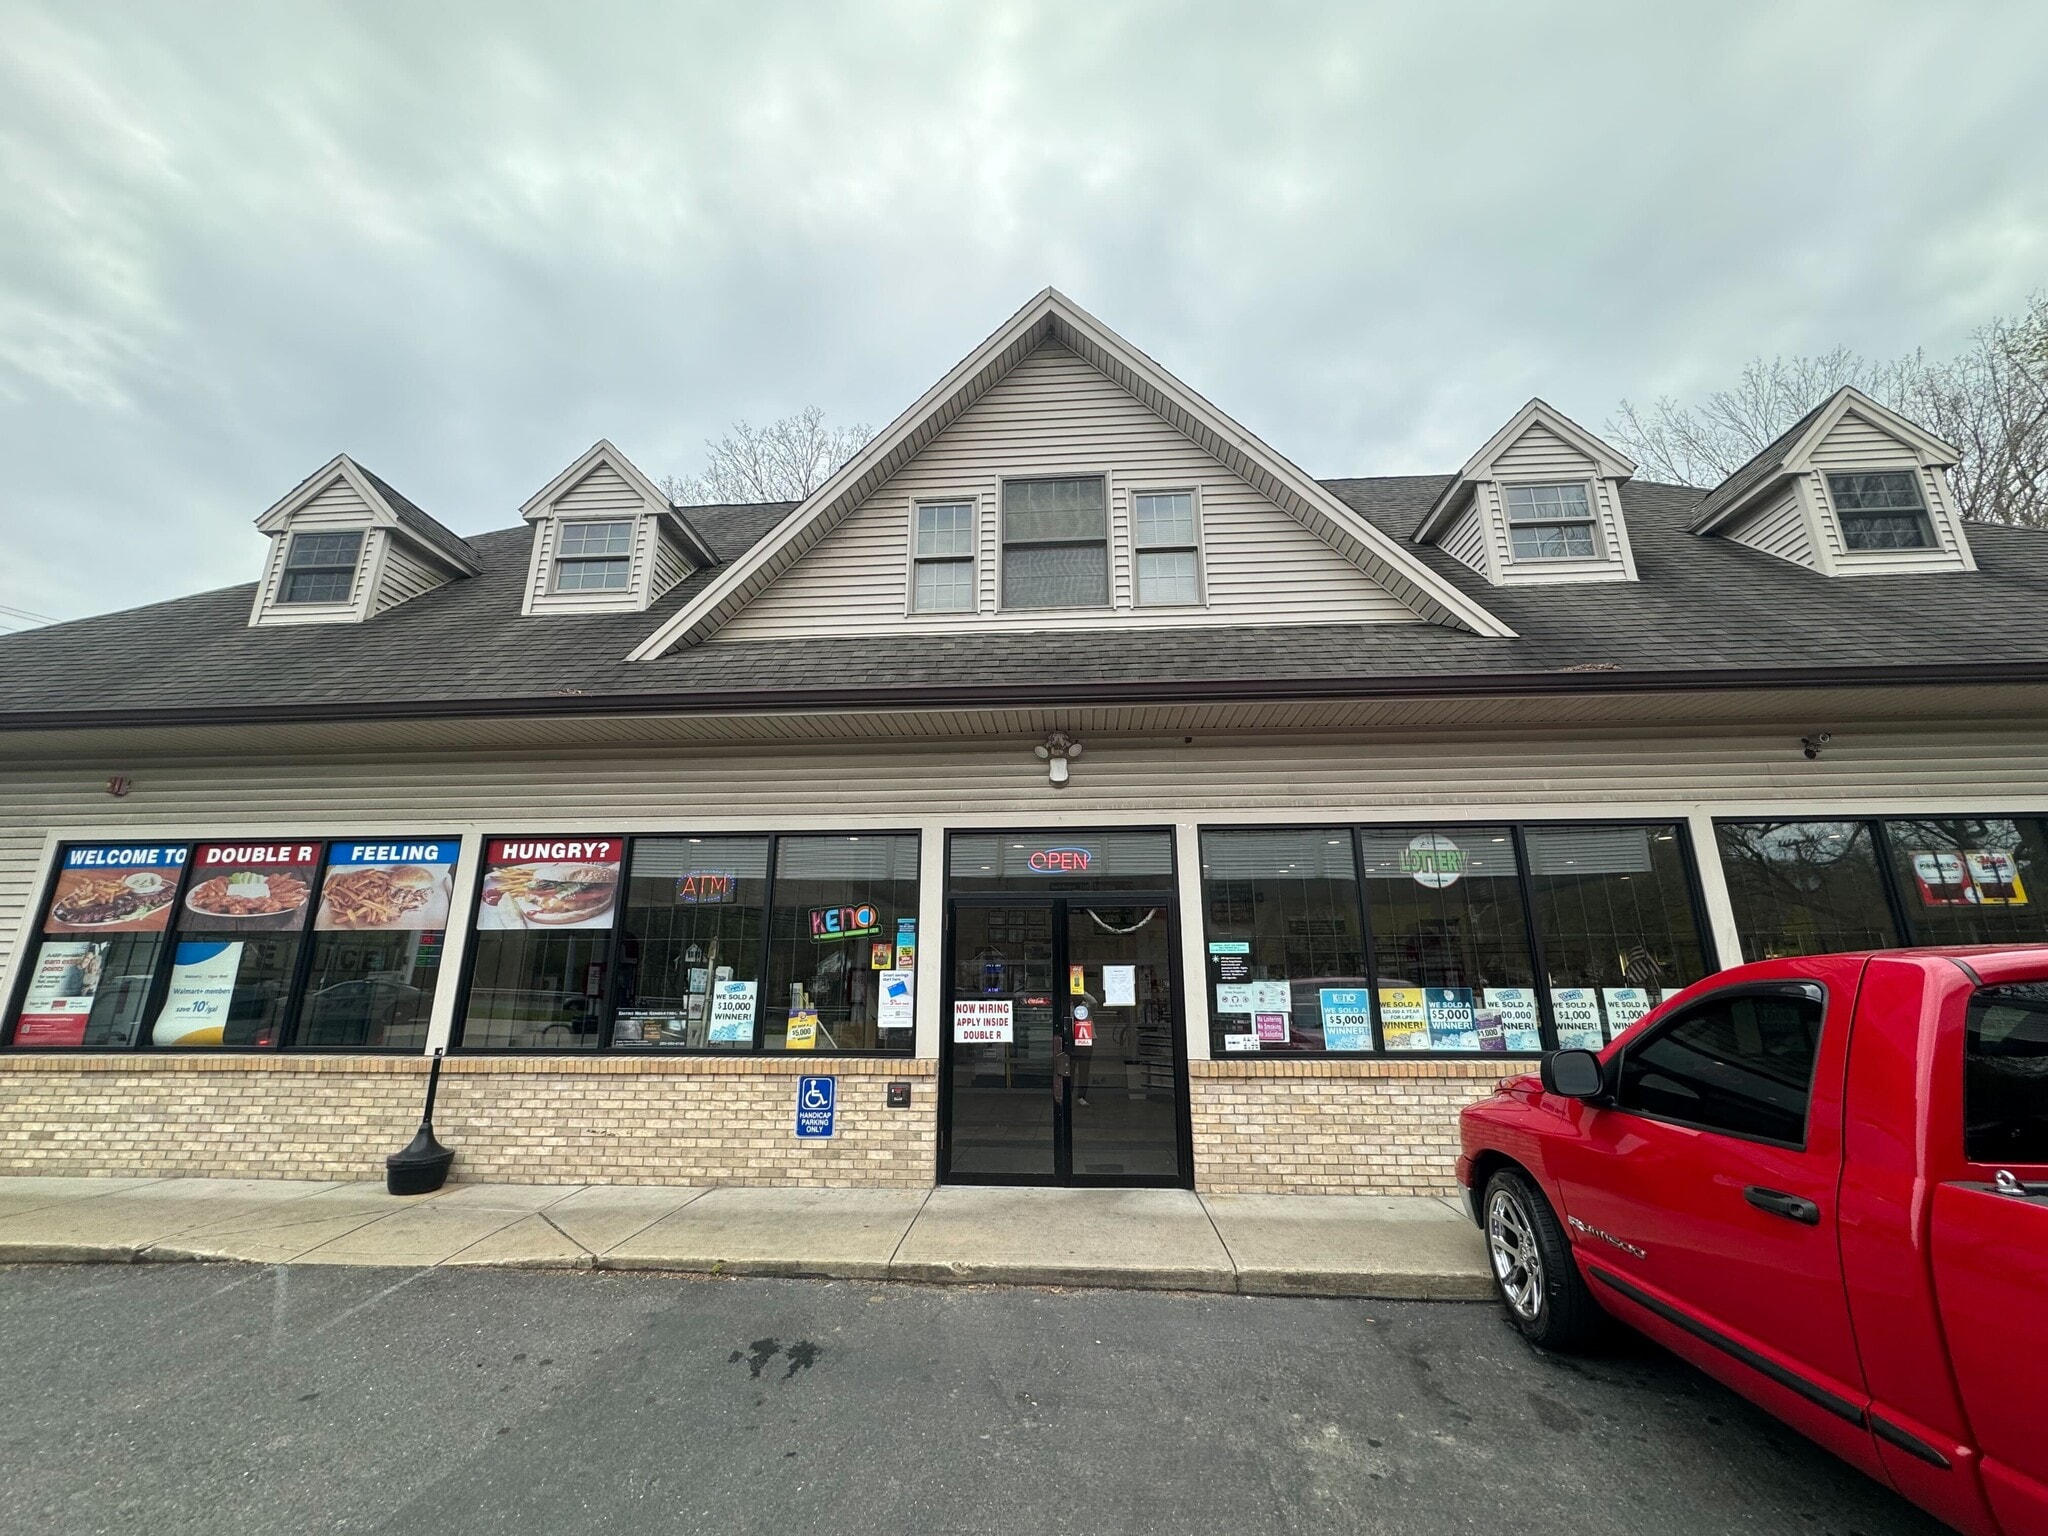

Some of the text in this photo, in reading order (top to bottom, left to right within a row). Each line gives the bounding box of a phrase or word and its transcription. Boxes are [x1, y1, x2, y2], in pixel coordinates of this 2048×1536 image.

[69, 848, 187, 865] WELCOME TO
[206, 846, 313, 864] DOUBLE R
[351, 845, 439, 861] FEELING
[502, 842, 610, 860] HUNGRY?
[1030, 852, 1087, 870] OPEN
[1400, 848, 1468, 873] LOTTERY
[681, 875, 728, 895] ATM
[811, 905, 876, 934] KENO
[204, 987, 231, 995] members
[718, 1002, 751, 1012] $10,000
[956, 1004, 1009, 1014] NOW HIRING
[1329, 1015, 1364, 1026] $5,000
[1432, 1010, 1469, 1021] $5,000
[1559, 1011, 1591, 1020] $1,000
[957, 1018, 1009, 1026] APPLY INSIDE
[1383, 1021, 1423, 1029] WINNER!
[1503, 1022, 1535, 1030] NNER!
[792, 1027, 812, 1037] $5,000
[963, 1031, 1002, 1040] DOUBLE R
